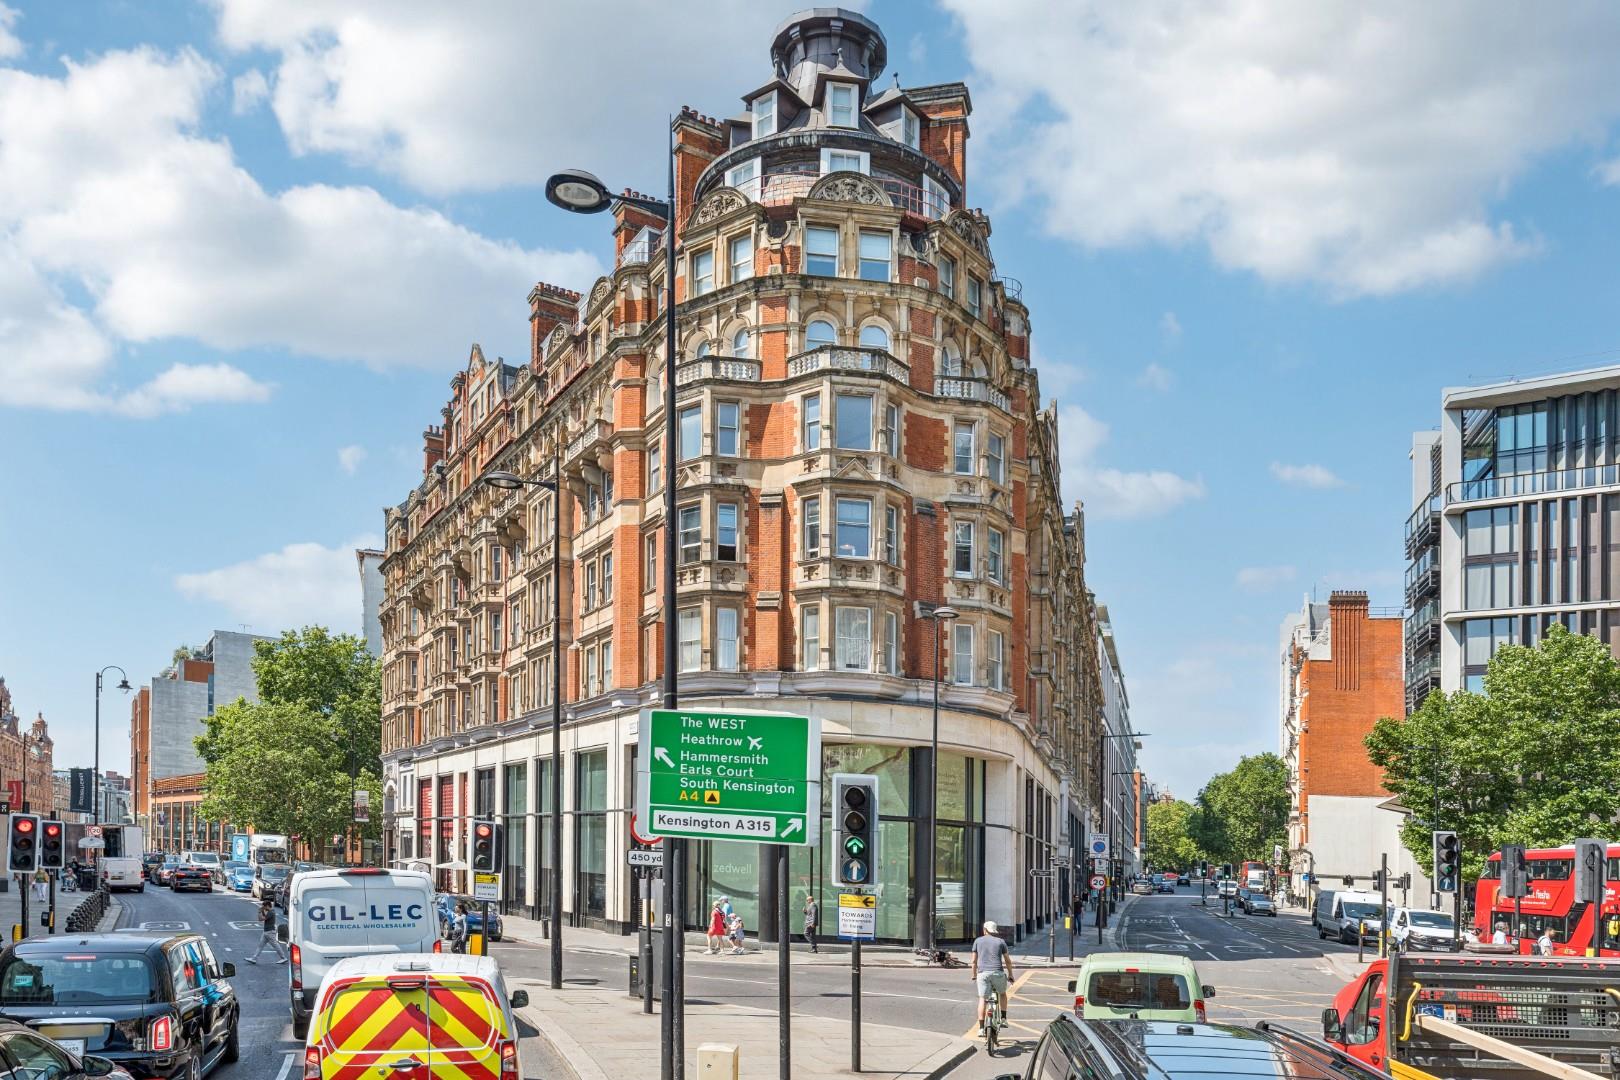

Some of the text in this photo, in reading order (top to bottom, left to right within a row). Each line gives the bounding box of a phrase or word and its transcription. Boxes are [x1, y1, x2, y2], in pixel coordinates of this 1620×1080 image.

[680, 717, 746, 730] The WEST
[681, 733, 743, 746] Heathrow
[680, 751, 769, 765] Hammersmith
[680, 764, 754, 777] Earls Court
[680, 778, 795, 794] South Kensington
[679, 790, 699, 802] A4
[658, 815, 771, 831] Kensington A315
[652, 855, 663, 863] yd
[713, 863, 752, 874] zedwell
[308, 904, 423, 921] GIL-LEC
